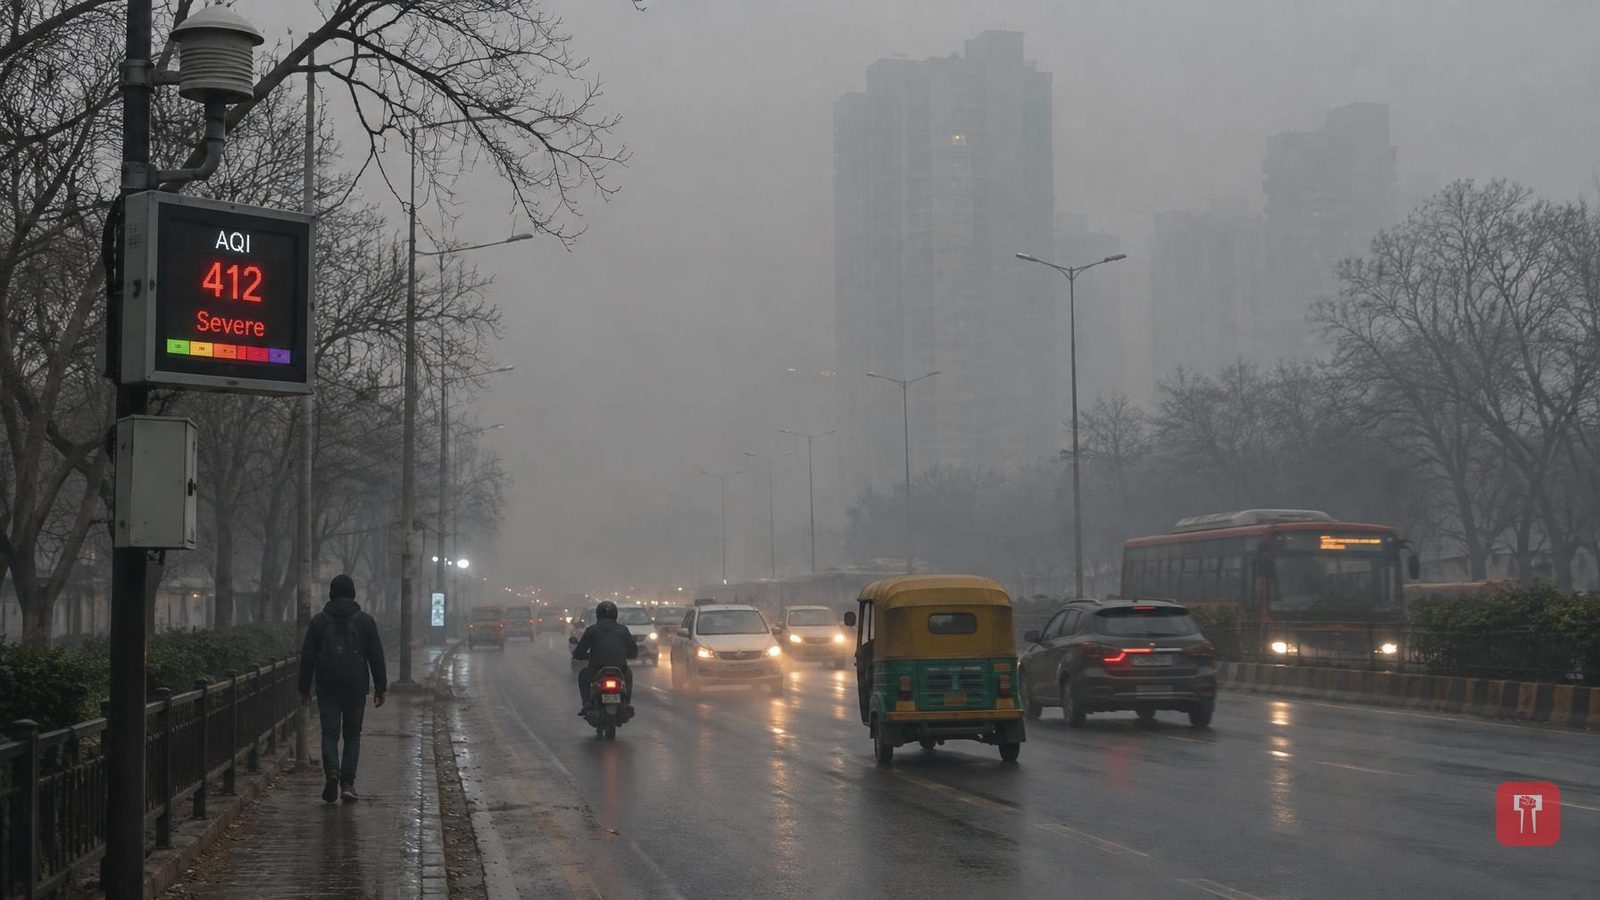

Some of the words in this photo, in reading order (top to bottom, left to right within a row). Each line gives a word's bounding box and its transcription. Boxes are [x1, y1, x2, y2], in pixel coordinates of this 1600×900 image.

[215, 230, 250, 254] AQI
[202, 262, 262, 303] 412
[196, 310, 265, 337] Severe
